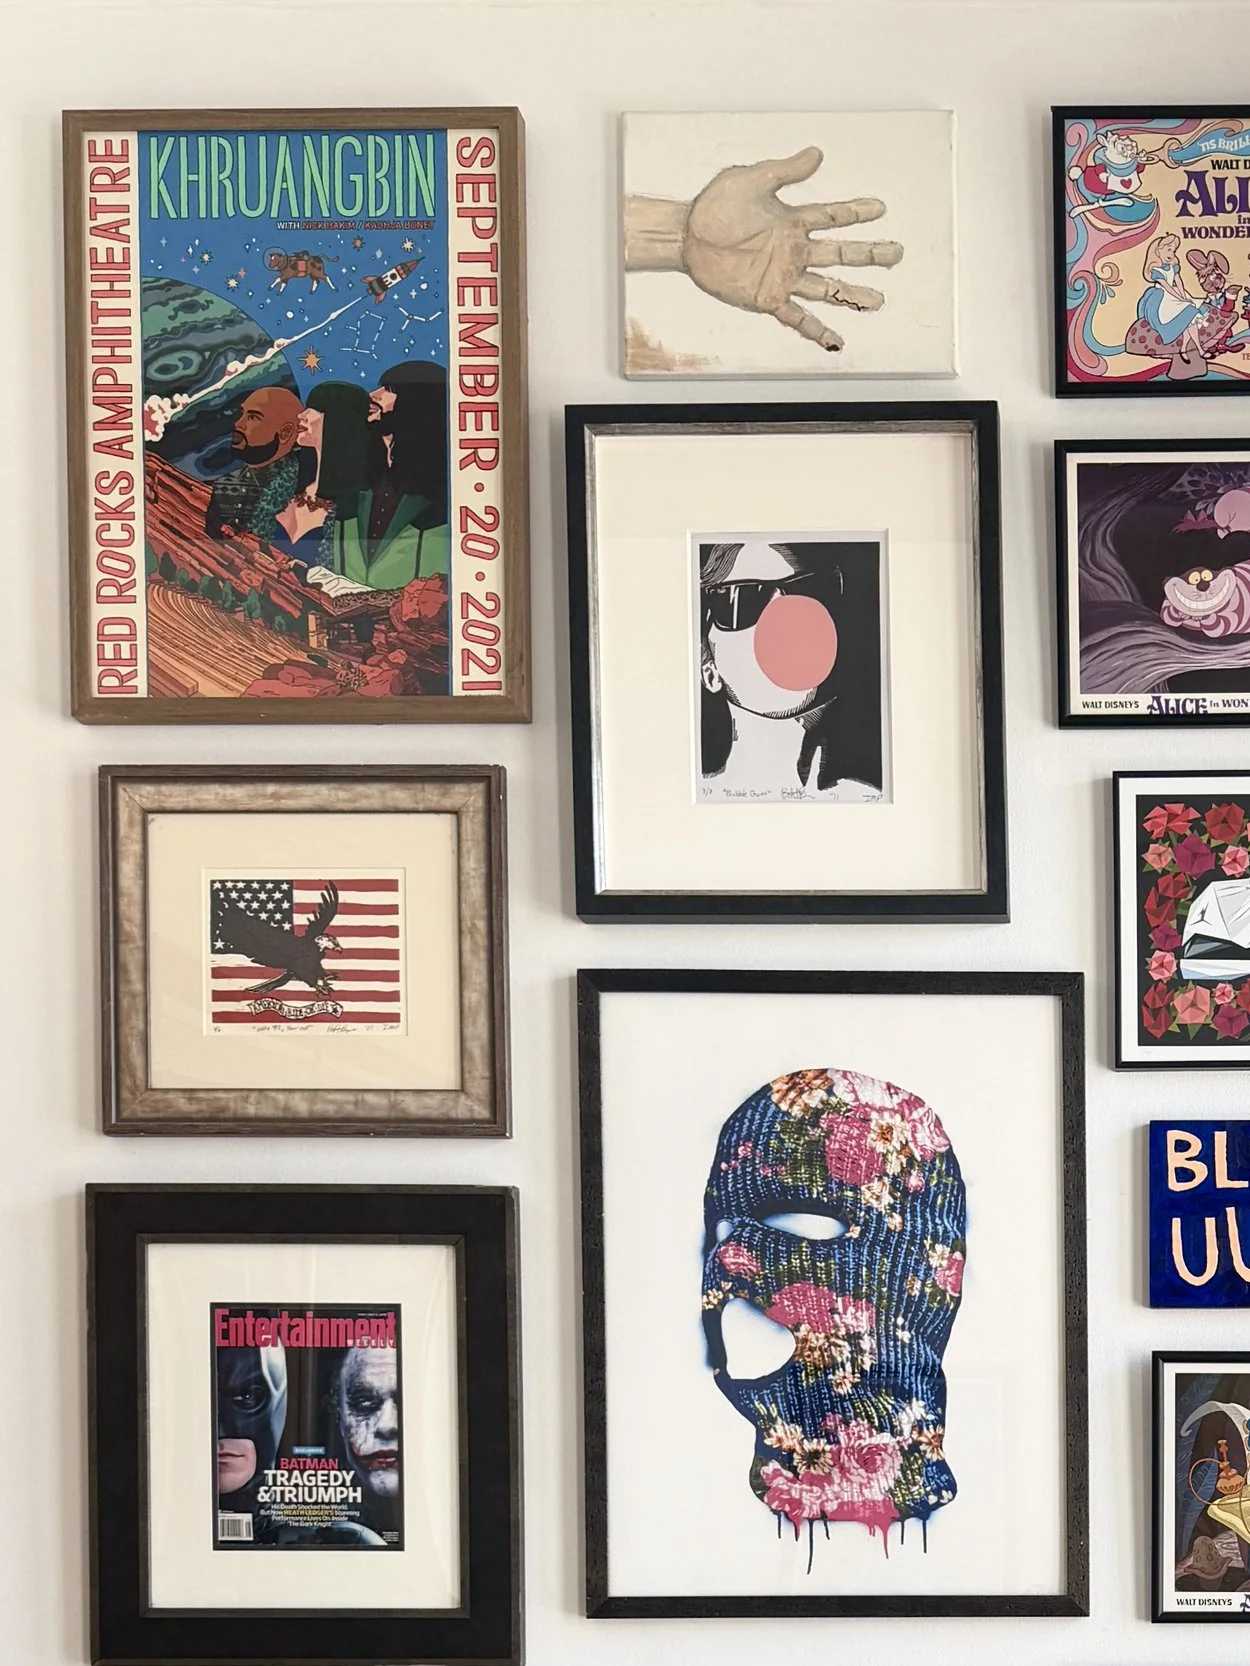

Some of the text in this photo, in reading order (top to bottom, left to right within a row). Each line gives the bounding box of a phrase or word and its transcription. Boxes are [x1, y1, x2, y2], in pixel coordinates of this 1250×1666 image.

[1210, 158, 1242, 170] WALT
[149, 134, 436, 220] KHRUANGBIN
[277, 221, 300, 230] WITH
[87, 139, 139, 695] RED ROCKS AMPHITHEATRE
[455, 136, 503, 691] SEPTEMBER 20 2021
[1082, 701, 1102, 709] WALT
[1146, 695, 1208, 715] ALICE
[214, 1307, 397, 1349] Entertainment
[346, 1338, 396, 1348] WEEKLY
[280, 1458, 339, 1470] BATMAN
[263, 1469, 355, 1487] TRAGEDY
[1176, 1598, 1197, 1606] WALT
